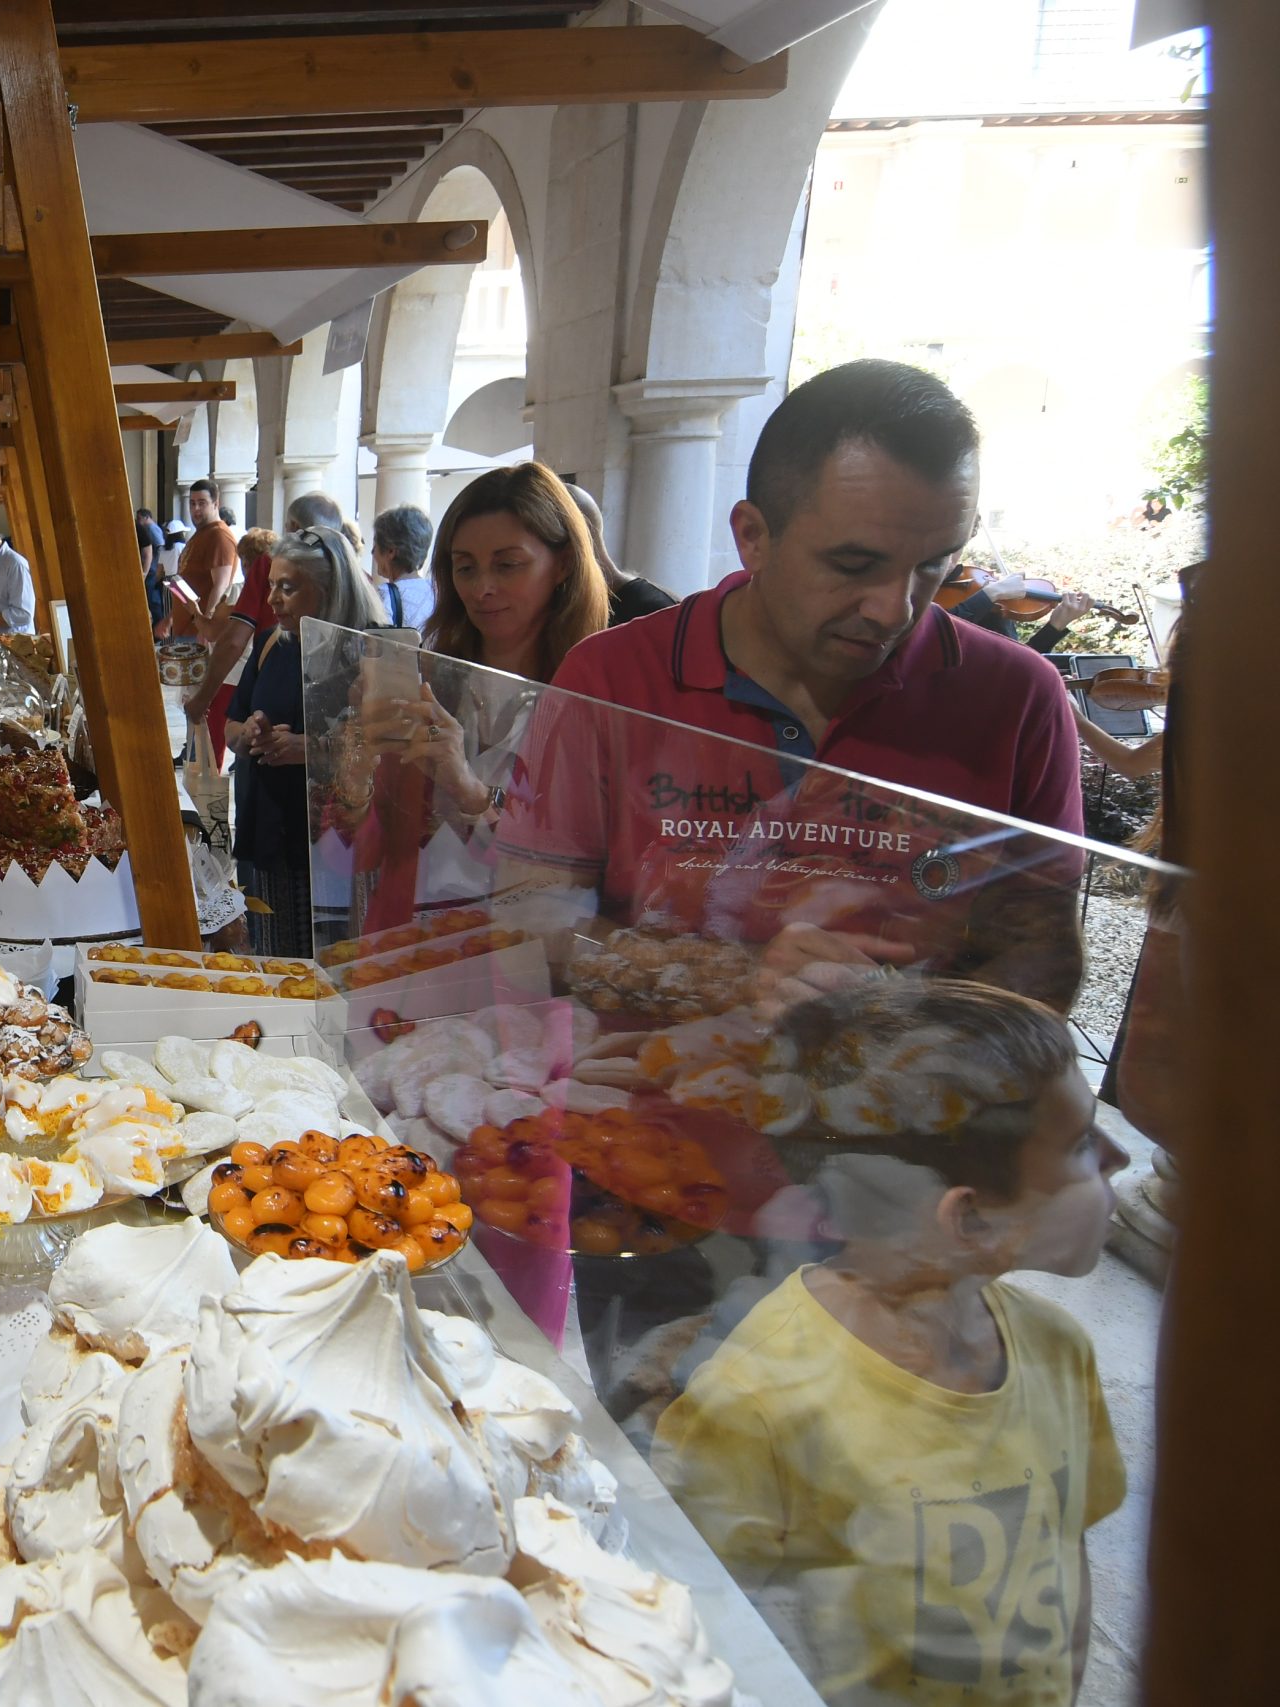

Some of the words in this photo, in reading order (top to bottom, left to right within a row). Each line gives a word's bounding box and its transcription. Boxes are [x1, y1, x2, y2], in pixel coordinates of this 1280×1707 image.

[660, 819, 739, 838] ROYAL
[748, 821, 911, 852] ADVENTURE
[676, 857, 729, 876] Sailing
[735, 862, 761, 870] and
[766, 859, 844, 878] Watersport
[843, 869, 878, 882] since
[880, 875, 899, 884] 48
